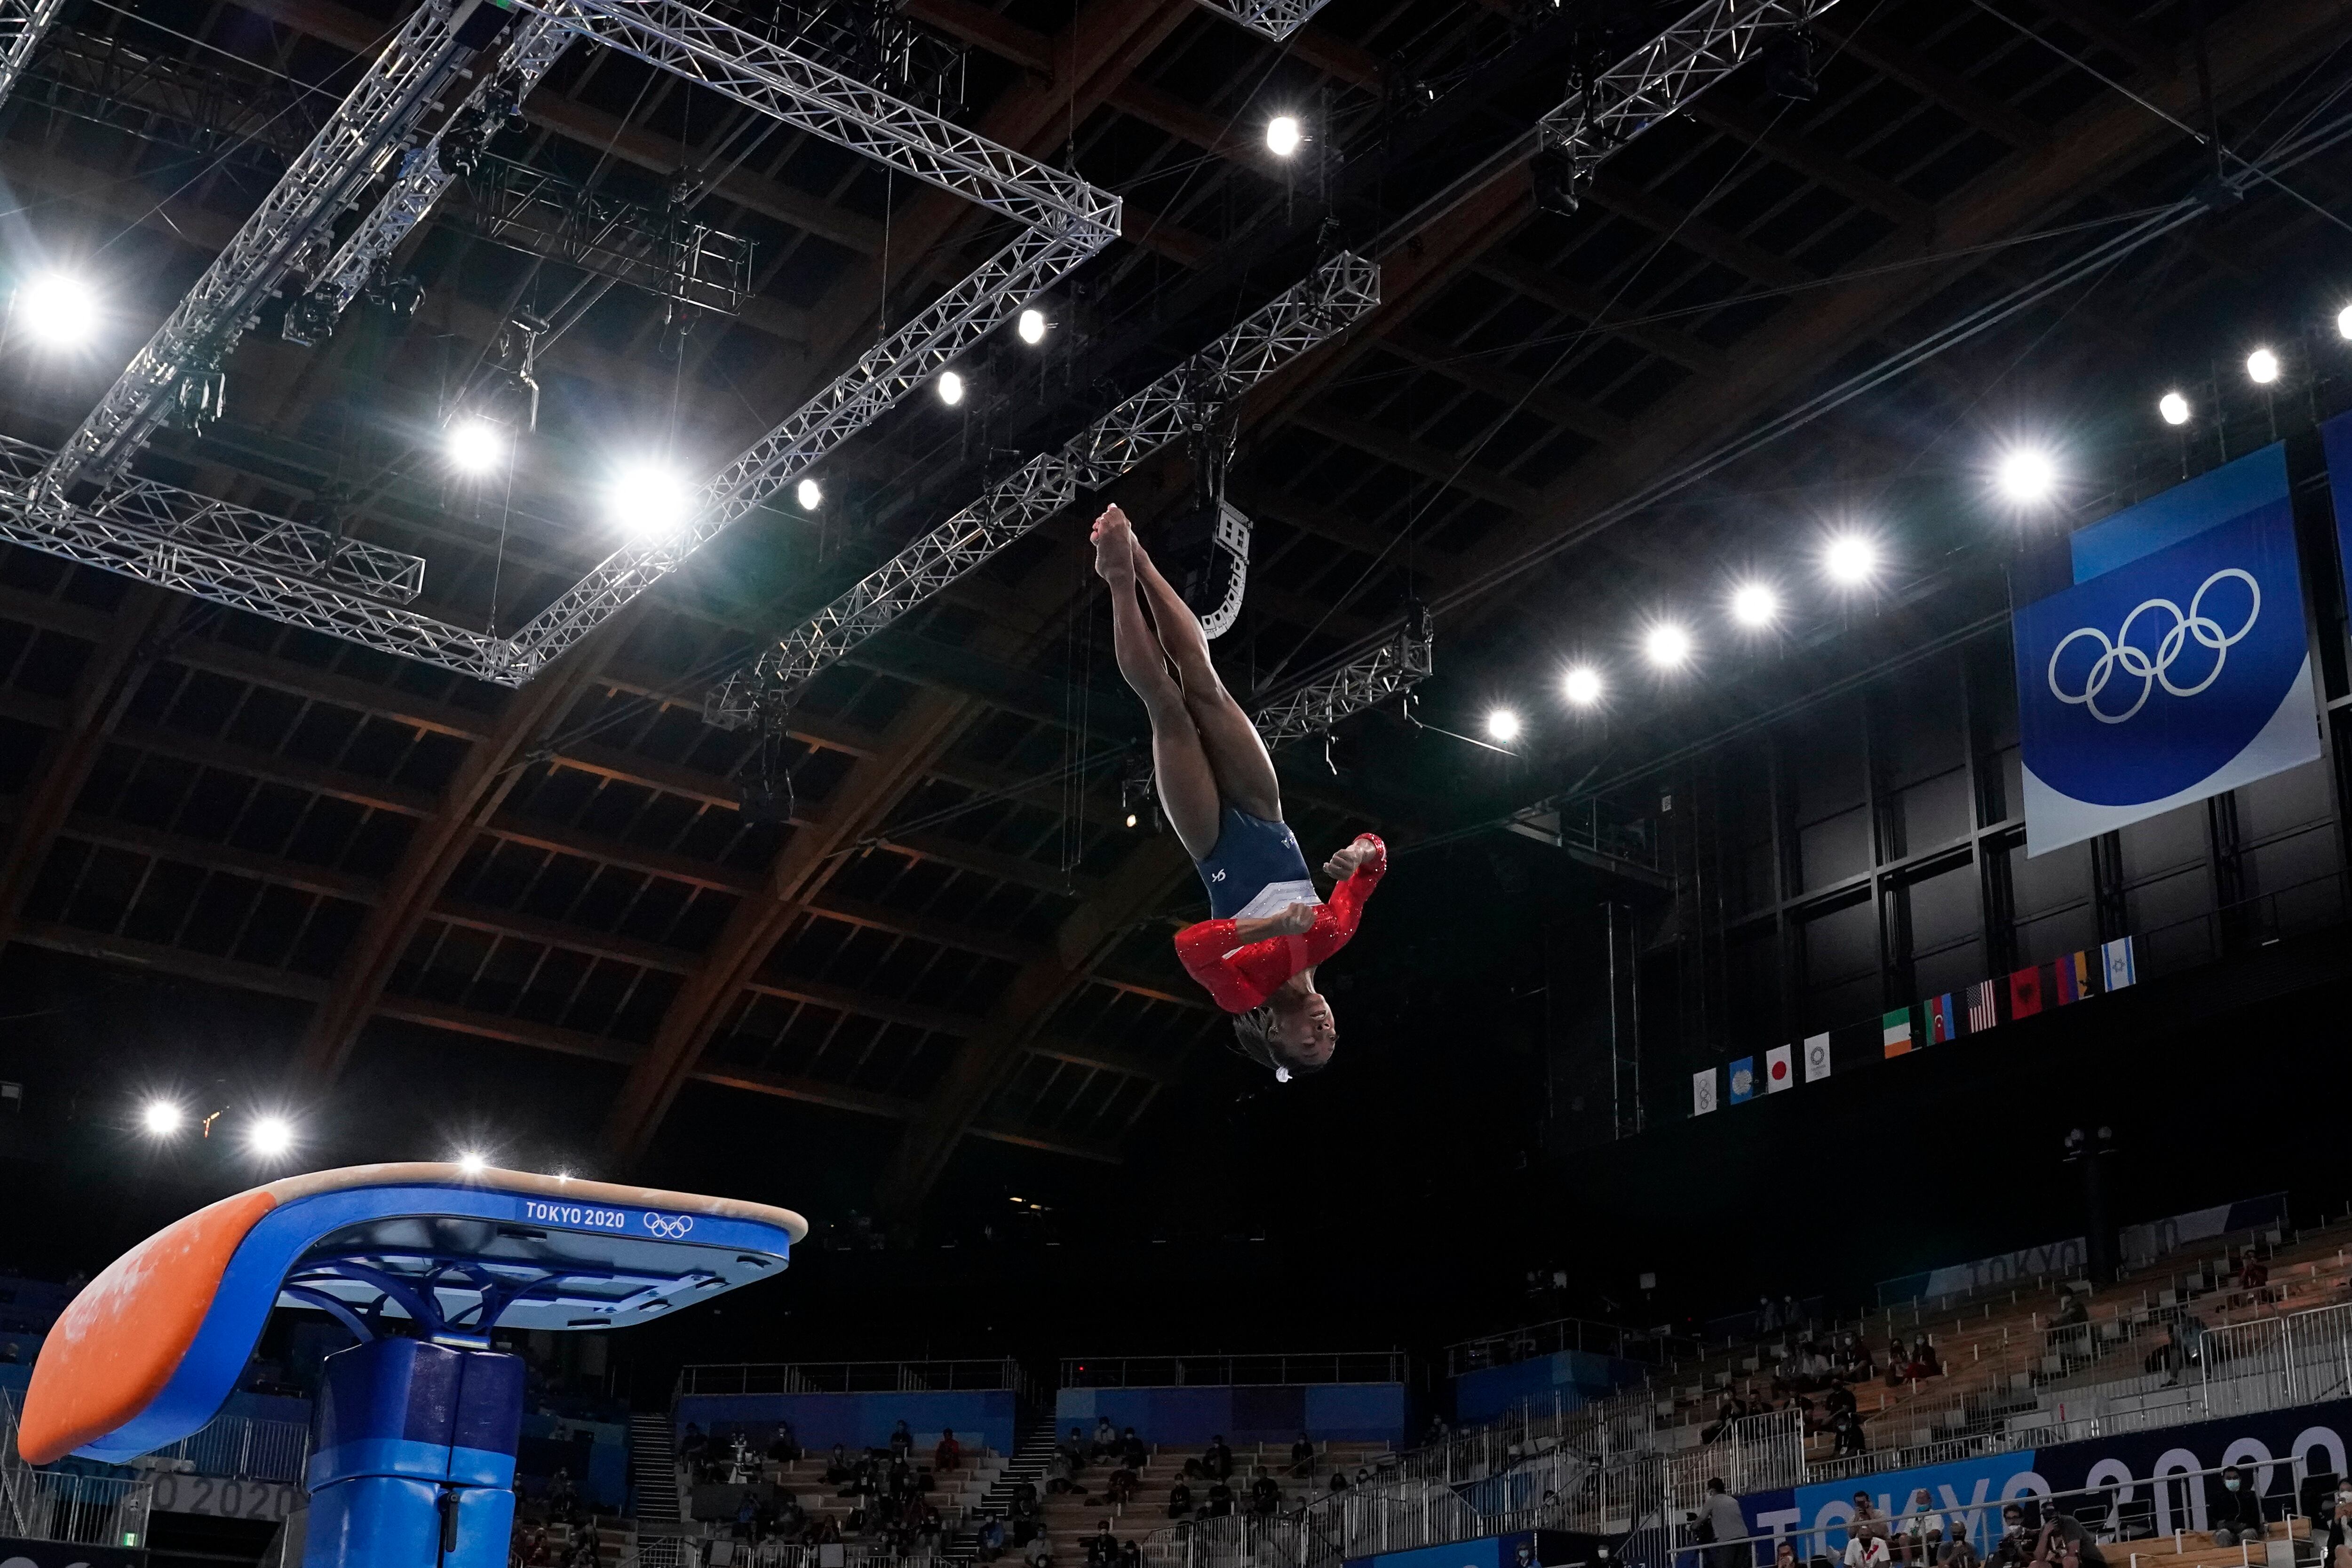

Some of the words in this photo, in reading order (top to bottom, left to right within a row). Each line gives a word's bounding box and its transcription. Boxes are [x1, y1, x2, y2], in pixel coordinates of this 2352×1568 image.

[526, 1202, 581, 1224] TOKYO
[584, 1209, 625, 1228] 2020
[190, 1477, 294, 1521] 2020
